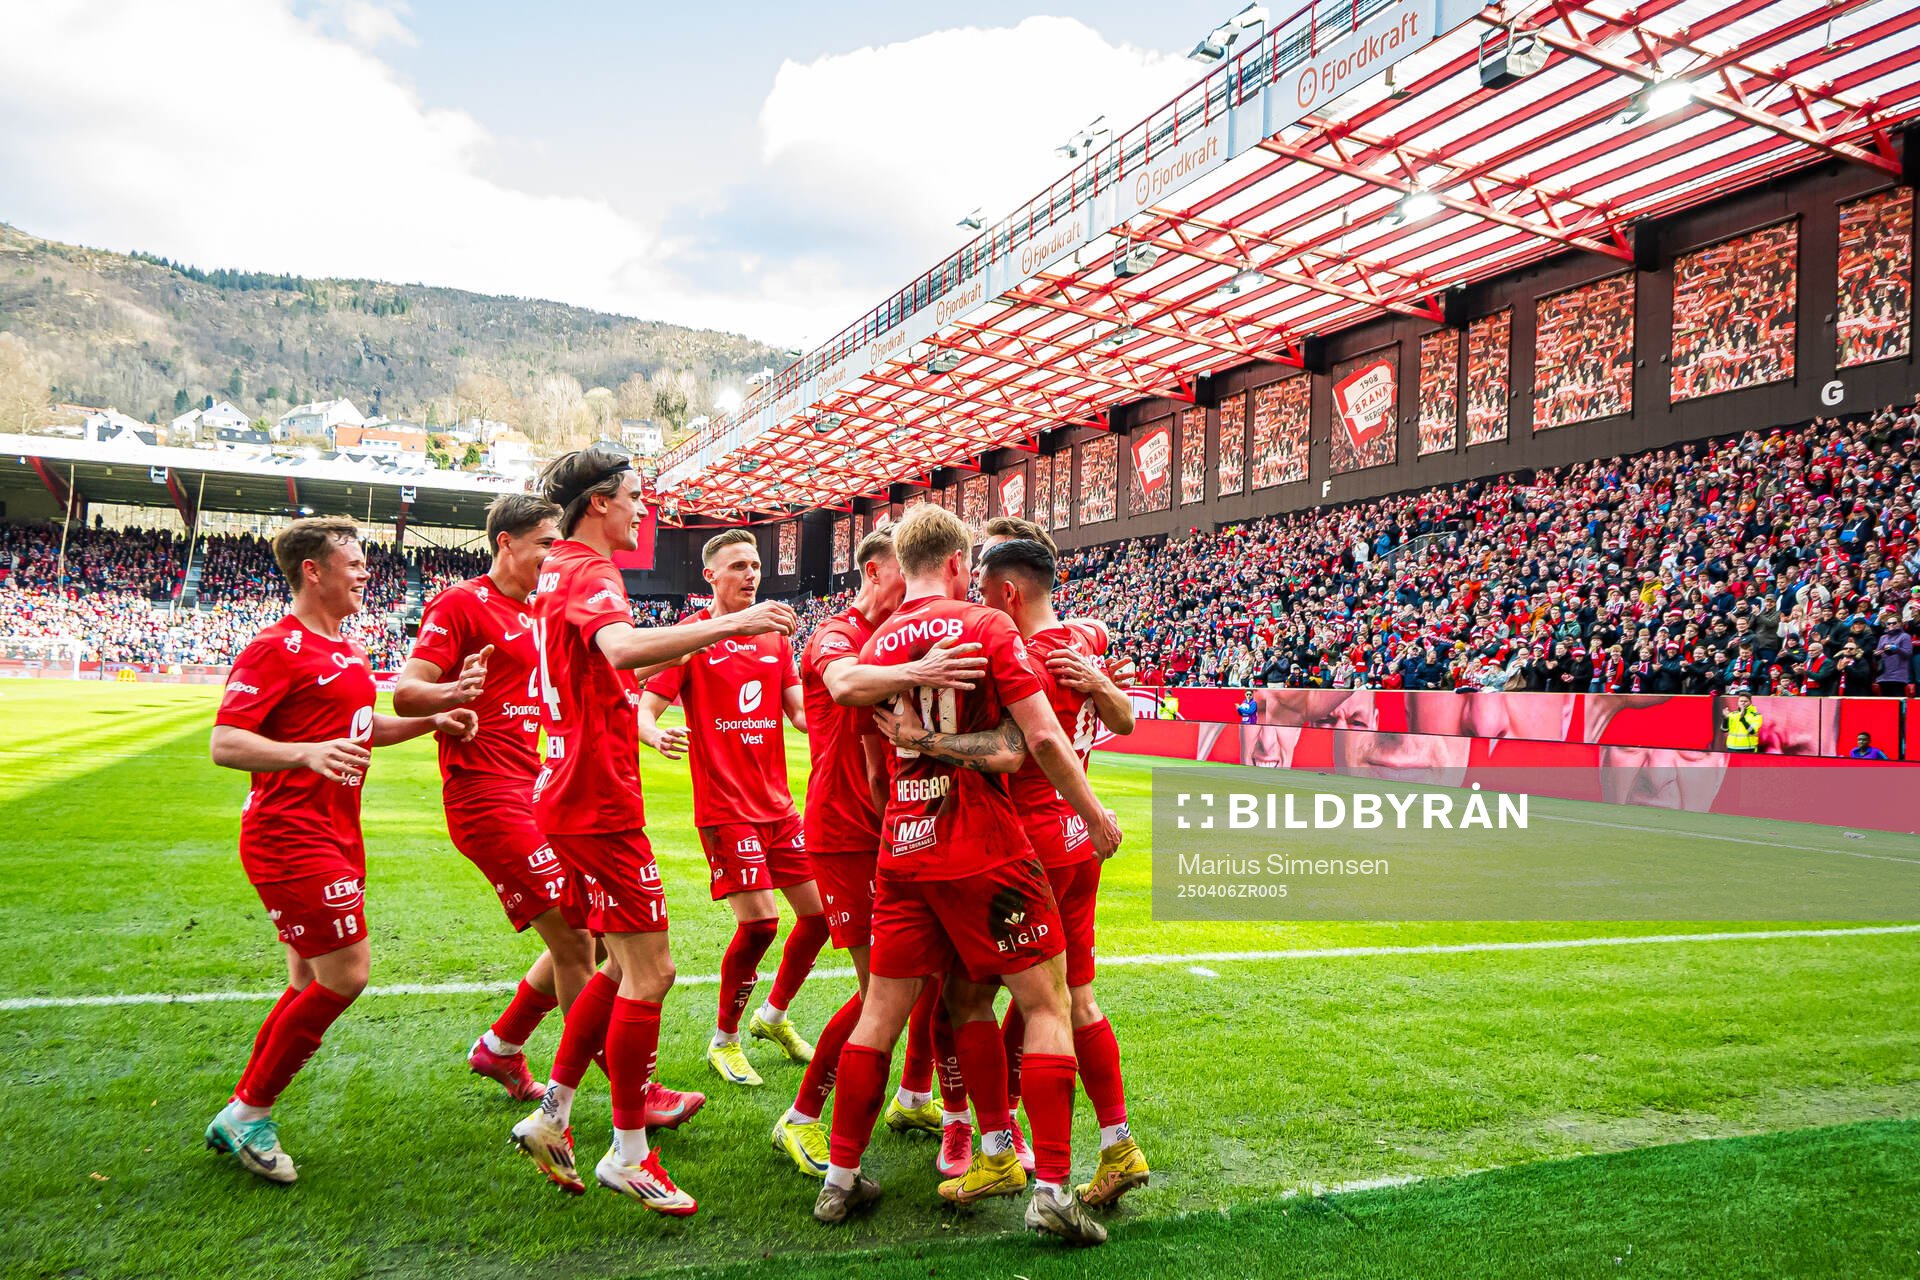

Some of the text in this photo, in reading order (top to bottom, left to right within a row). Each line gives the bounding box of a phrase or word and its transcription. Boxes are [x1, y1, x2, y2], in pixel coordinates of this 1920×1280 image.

[1321, 11, 1418, 94] Fjordkraft
[1152, 136, 1218, 196] Fjordkraft
[1033, 221, 1081, 269] Fjordkraft
[945, 282, 982, 319] Fjordkraft
[1360, 374, 1379, 390] 1908
[1821, 380, 1844, 406] G
[1322, 480, 1332, 498] F
[874, 618, 963, 657] FOTMOB
[741, 733, 763, 744] Vest
[897, 775, 950, 802] HEGGBØ
[527, 847, 558, 868] LER
[740, 867, 758, 885] 17
[649, 898, 667, 922] 14
[333, 914, 358, 939] 19
